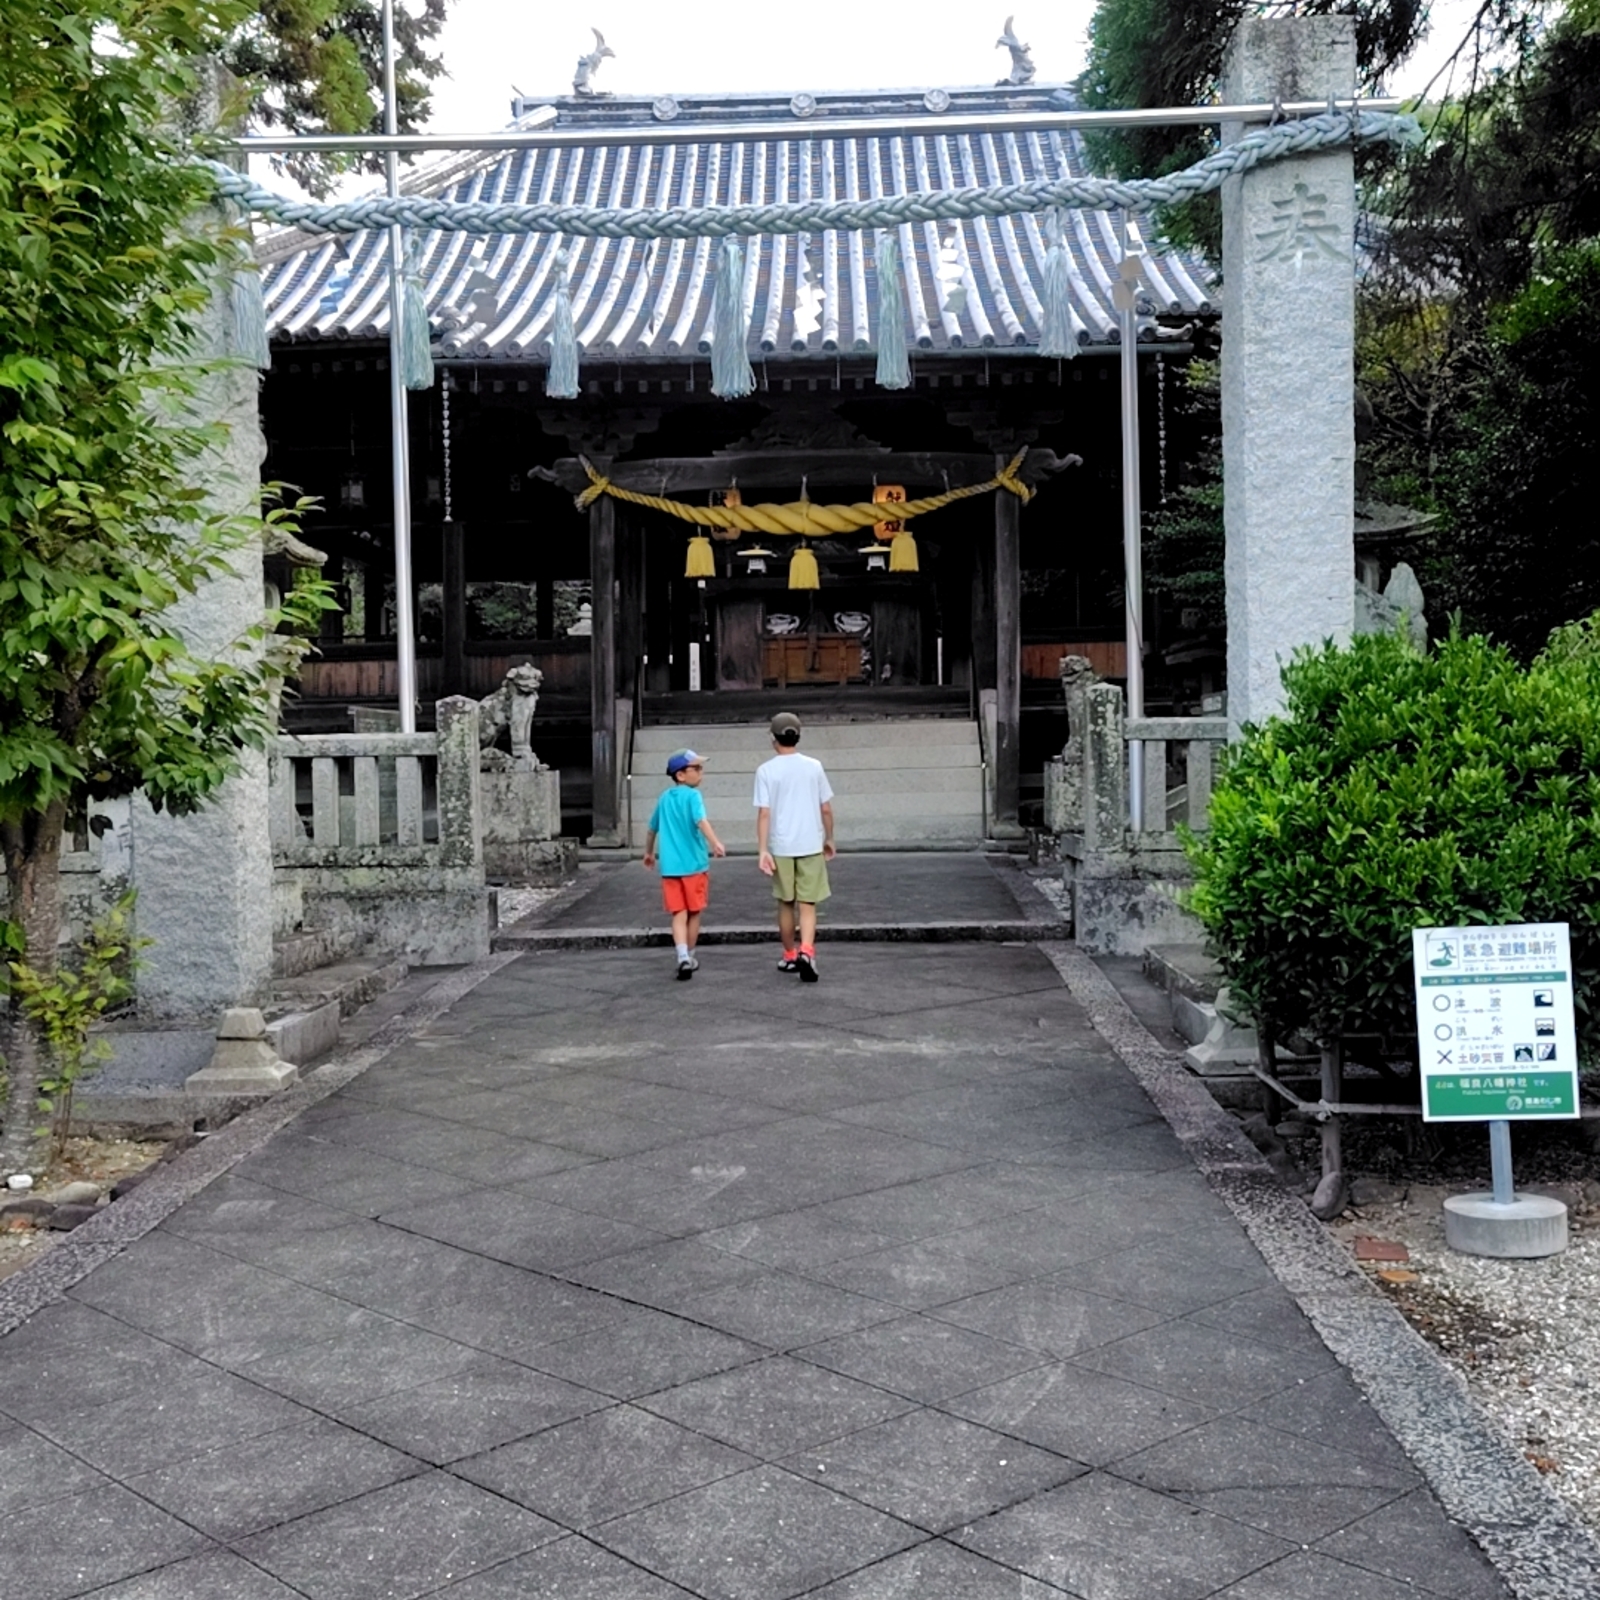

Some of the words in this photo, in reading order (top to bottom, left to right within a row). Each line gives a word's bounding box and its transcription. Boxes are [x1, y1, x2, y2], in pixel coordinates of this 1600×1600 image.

[1255, 182, 1352, 270] 奉
[1463, 940, 1557, 957] 緊急避難場所
[1457, 1052, 1505, 1064] 土砂災害
